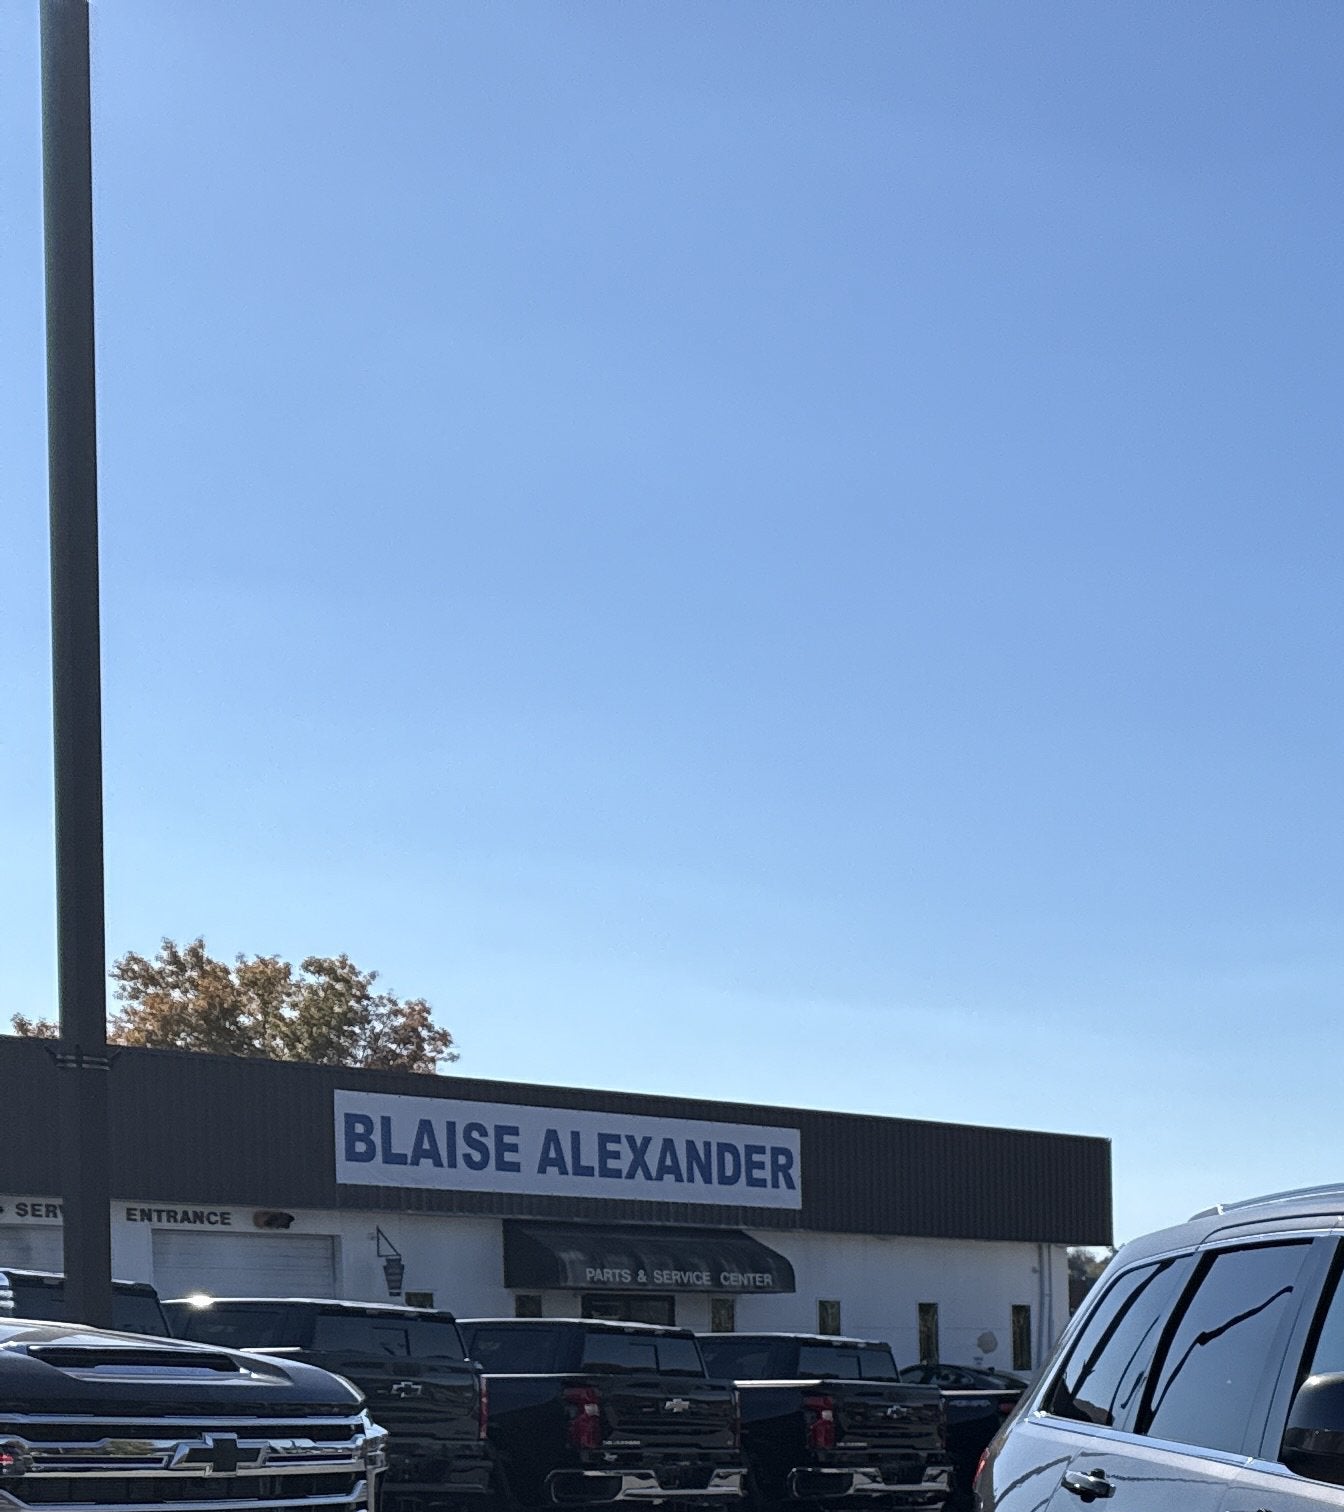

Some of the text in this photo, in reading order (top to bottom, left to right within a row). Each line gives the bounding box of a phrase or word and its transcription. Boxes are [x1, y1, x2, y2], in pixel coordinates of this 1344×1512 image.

[344, 1112, 796, 1190] BLAISE ALEXANDER
[126, 1207, 232, 1226] ENTRANCE
[586, 1268, 772, 1286] PARTS & SERVICE CENTER
